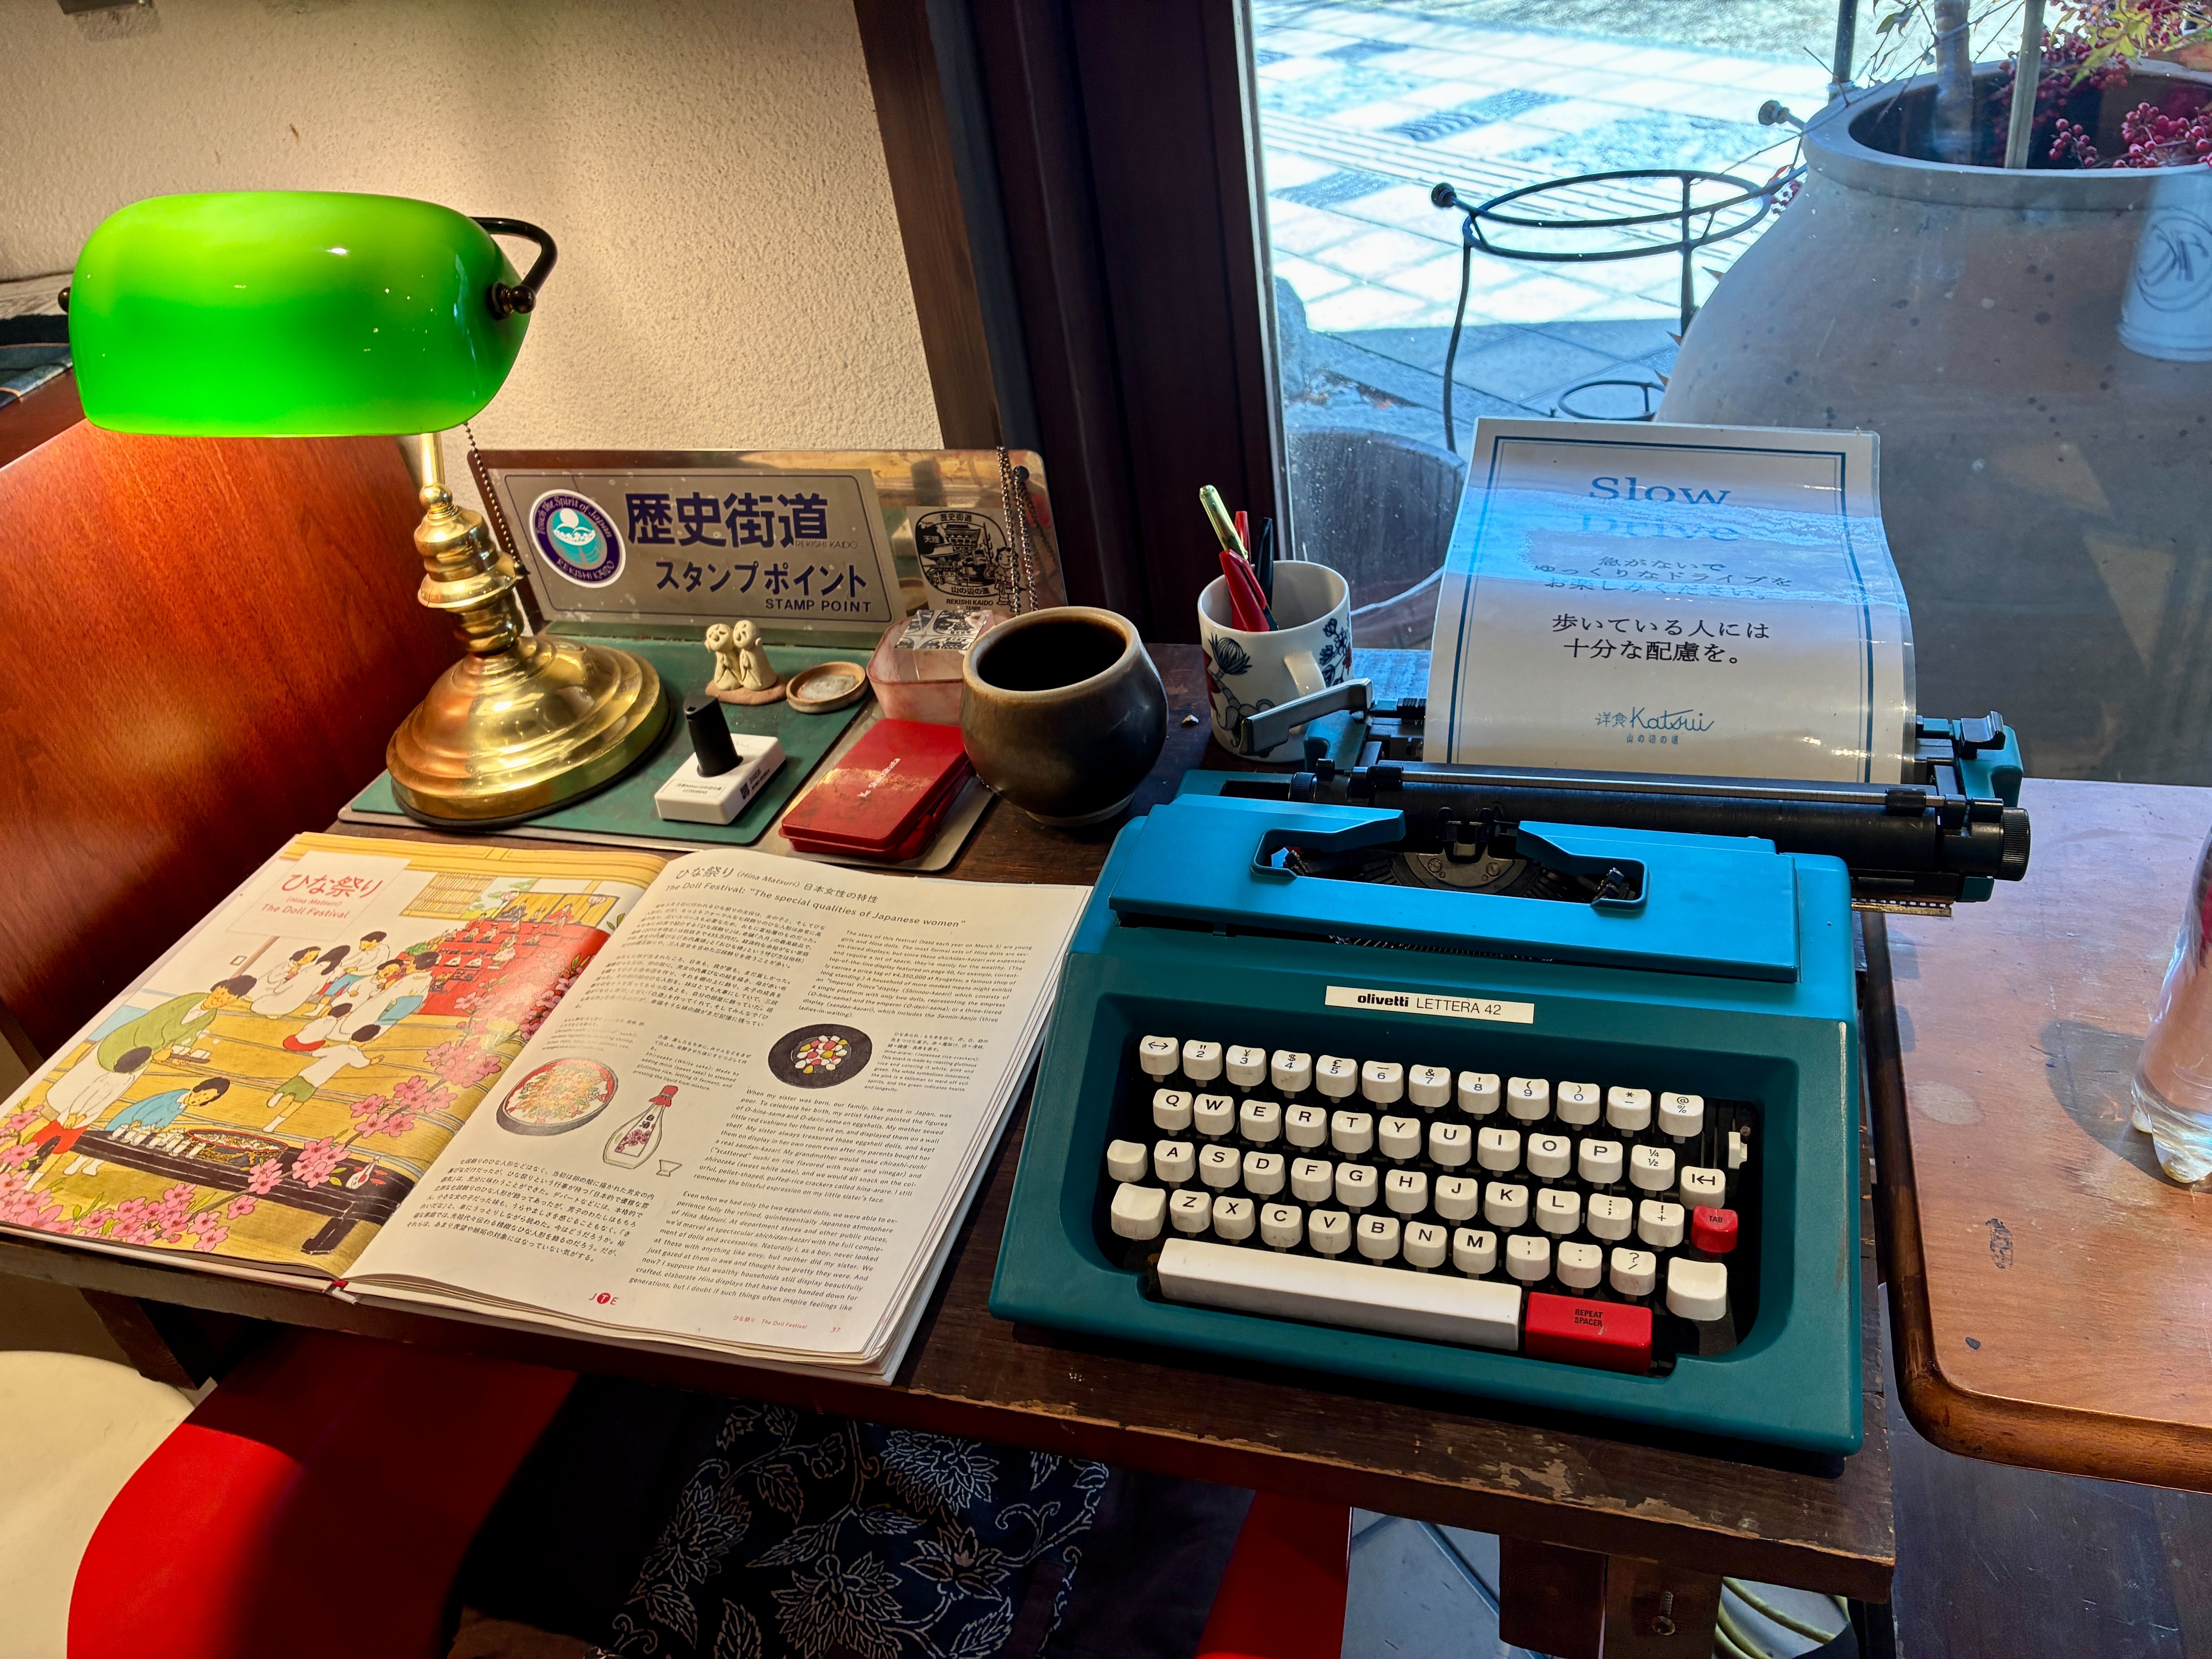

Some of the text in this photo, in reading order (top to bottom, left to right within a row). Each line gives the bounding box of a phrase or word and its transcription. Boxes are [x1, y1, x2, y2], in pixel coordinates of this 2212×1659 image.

[1589, 477, 1731, 504] Slow
[554, 496, 579, 508] Spirit
[579, 503, 589, 514] of
[588, 509, 612, 538] Japan
[625, 492, 828, 548] 歴史街道
[795, 540, 858, 549] REKISHI KAIDO
[557, 558, 614, 580] REKISHI KAIDO
[1598, 556, 1726, 571] 急がないで
[656, 560, 867, 598] スタンプポイント
[951, 586, 990, 595] 山の辺の道
[766, 599, 872, 613] STAMP POINT
[1553, 613, 1769, 638] 歩いている人には
[1563, 638, 1738, 663] 十分な配慮を。
[1595, 707, 1714, 732] 洋食 Katsui
[1627, 734, 1678, 744] 山の辺の道
[282, 874, 383, 899] ひな祭り
[676, 866, 878, 903] ひな祭り (Hina Matsuri) 日本女性の特性
[261, 903, 350, 919] The Doll Festival
[704, 883, 745, 894] Festival:
[750, 888, 772, 898] “The
[775, 895, 811, 906] special
[812, 903, 857, 915] qualities
[872, 912, 920, 924] Japanese
[1358, 993, 1501, 1015] olivetti LETTERA 42
[1166, 1095, 1607, 1156] Q W E R T Y U I O P
[1167, 1147, 1564, 1207] A S D F G H J K L
[676, 1201, 706, 1210] perience
[707, 1205, 723, 1214] fully
[737, 1211, 762, 1219] refined,
[764, 1214, 818, 1226] quintessentially
[819, 1220, 851, 1228] Japanese
[852, 1224, 893, 1233] atmosphere
[1183, 1197, 1483, 1248] Z X C V B N M
[1575, 1309, 1603, 1319] REPEAT
[1575, 1317, 1602, 1327] SPACER
